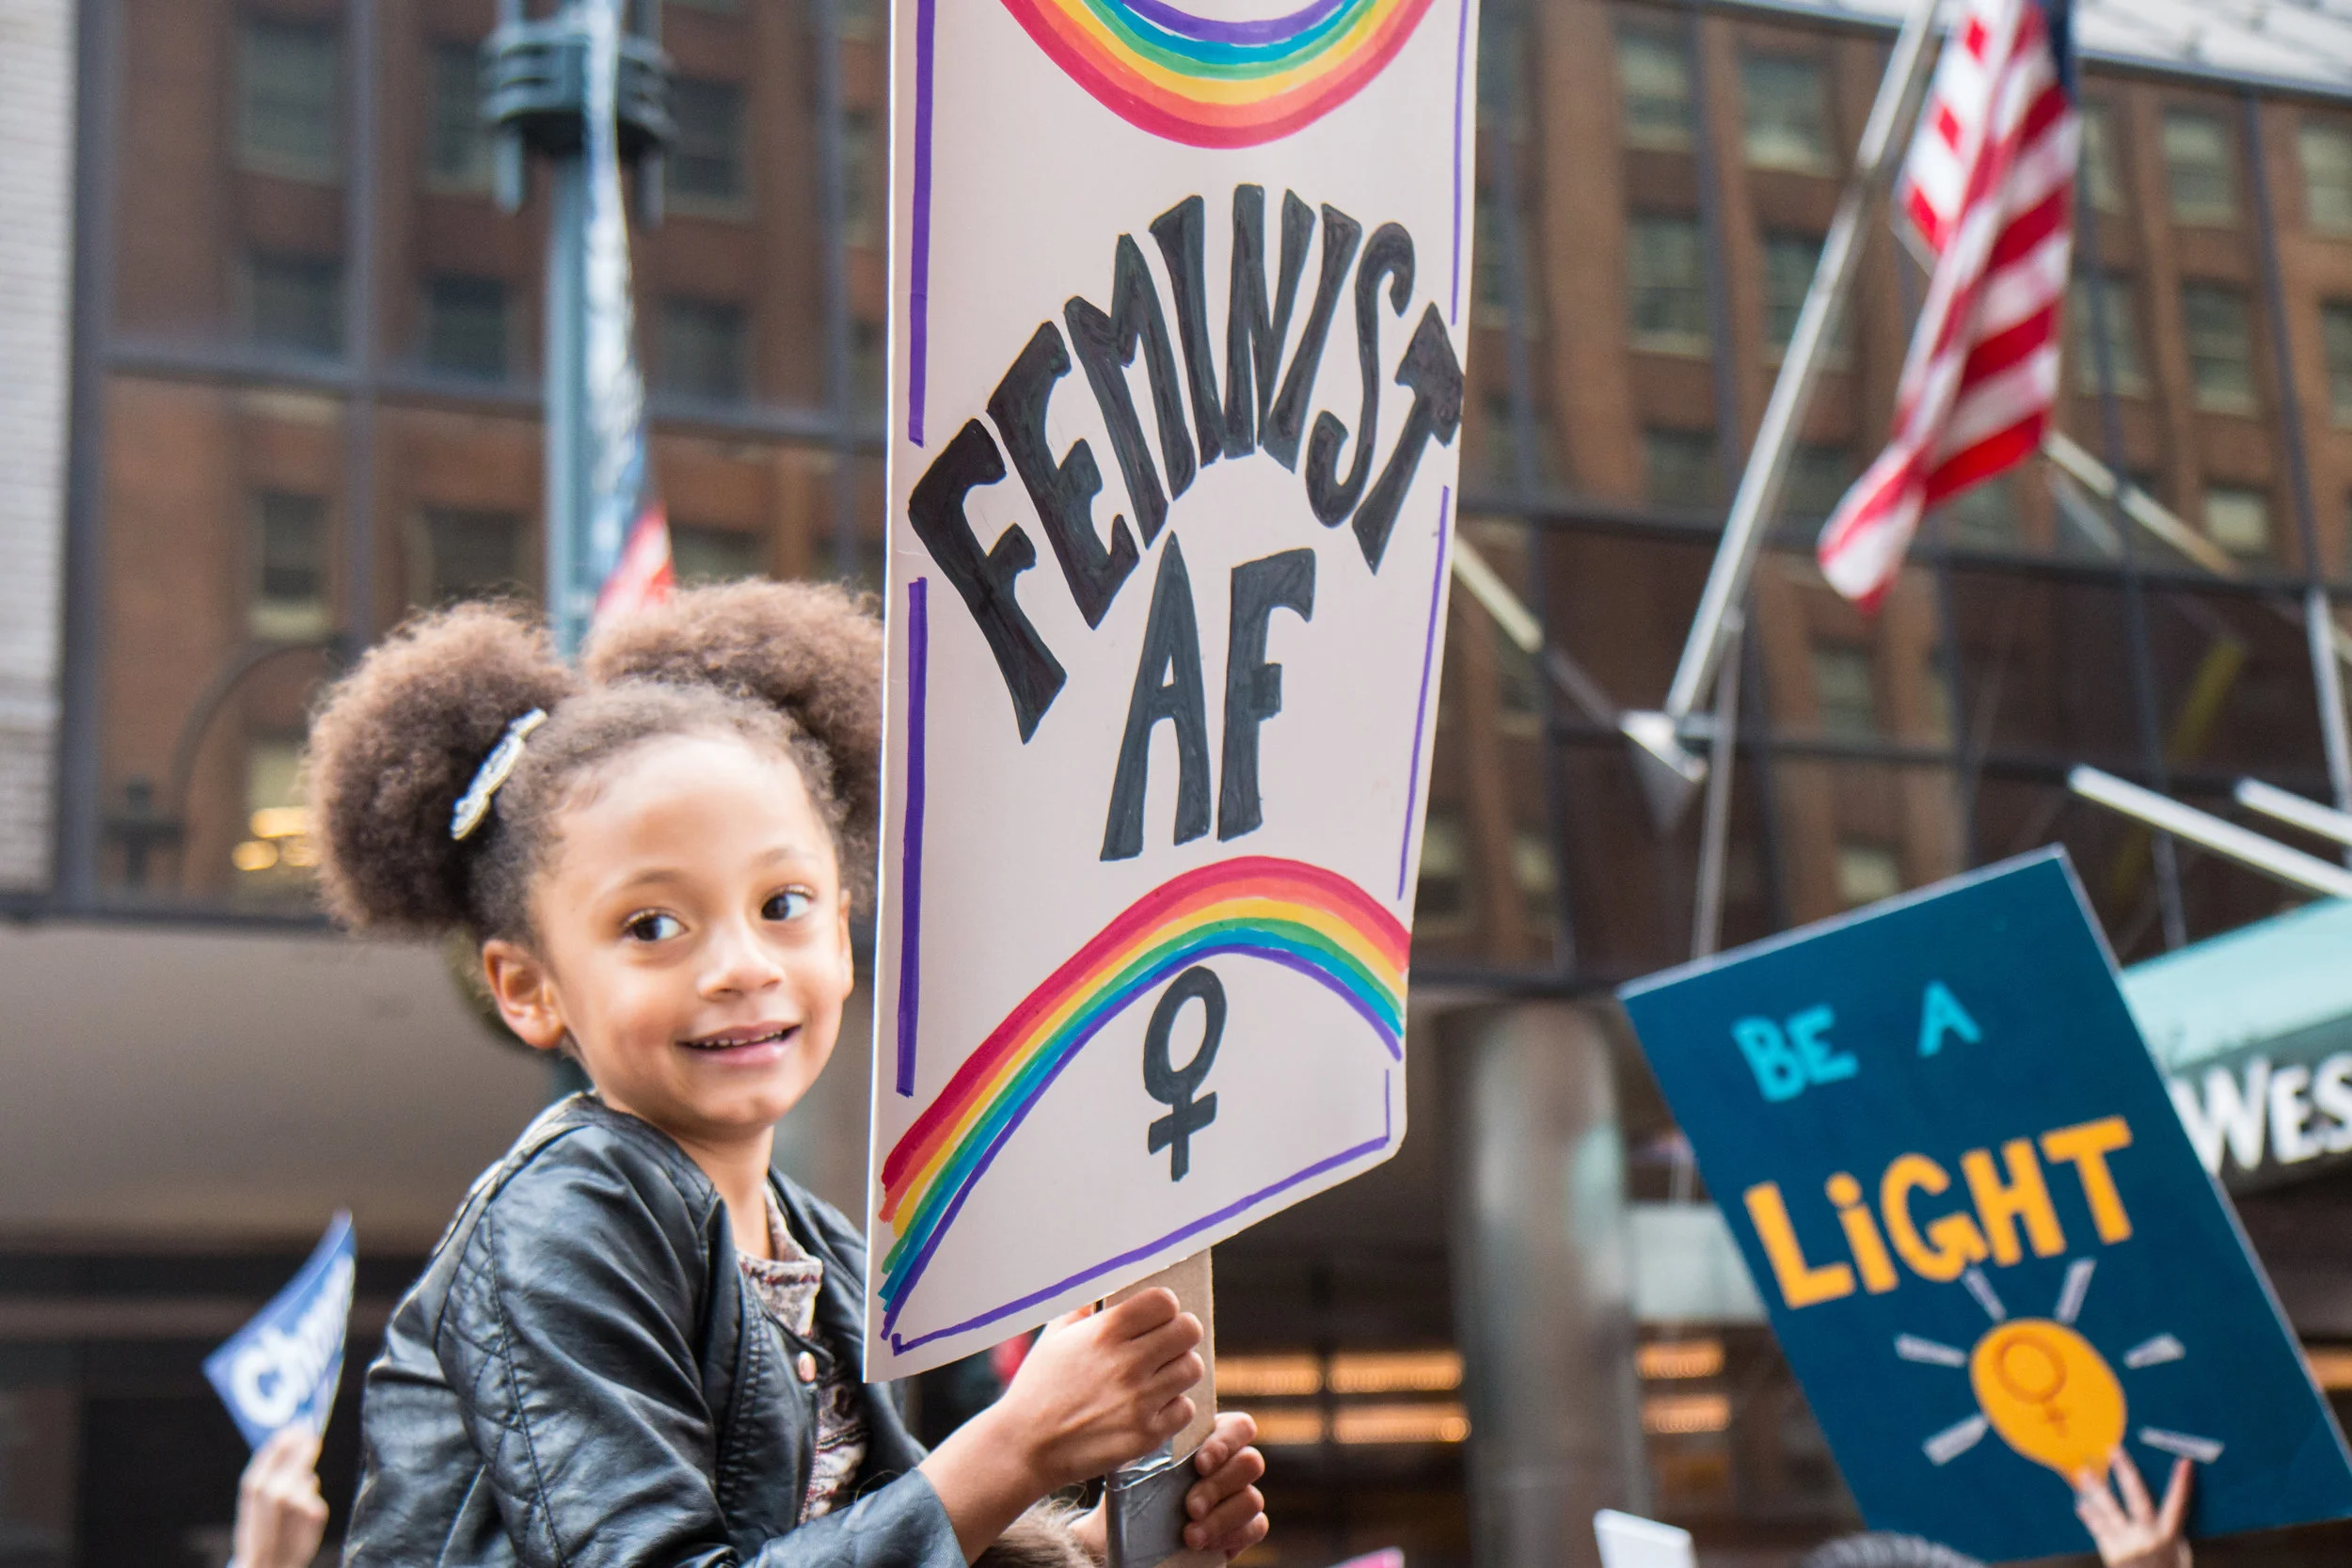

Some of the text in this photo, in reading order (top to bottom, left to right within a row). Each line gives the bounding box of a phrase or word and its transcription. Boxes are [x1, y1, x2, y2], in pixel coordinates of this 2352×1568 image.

[909, 183, 1464, 744] FEMINIST
[1100, 531, 1315, 861] AF
[1732, 981, 1981, 1101] BE A
